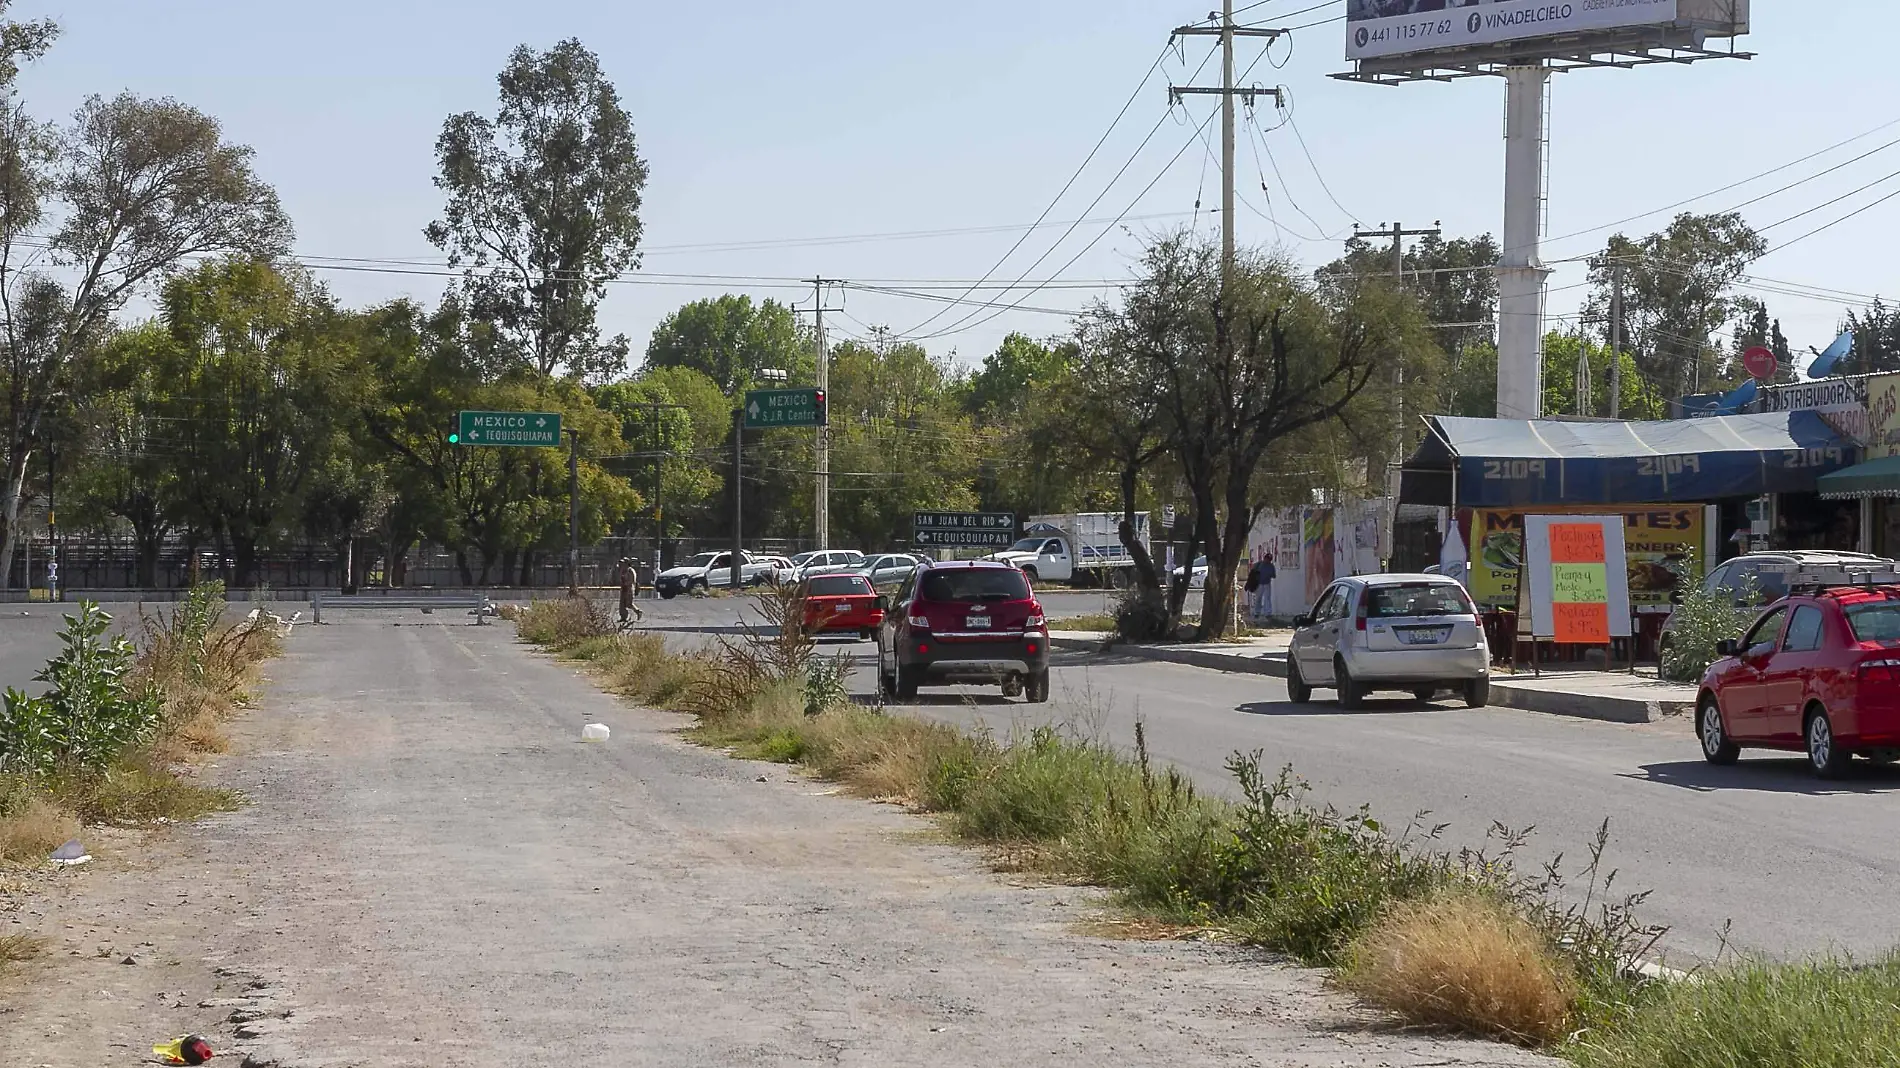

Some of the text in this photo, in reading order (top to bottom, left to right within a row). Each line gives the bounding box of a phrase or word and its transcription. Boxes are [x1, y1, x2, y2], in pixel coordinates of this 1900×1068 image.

[1371, 27, 1391, 42] 441
[1396, 25, 1416, 40] 115
[1420, 22, 1434, 36] 77
[1437, 19, 1451, 34] 62
[1485, 4, 1572, 28] VIÑADELCIELO
[769, 395, 808, 407] MEXICO
[1772, 384, 1851, 411] DISTRIBUIDORA
[474, 416, 526, 427] MEXICO
[486, 430, 553, 442] TEQUISQUIAPAN
[917, 515, 995, 526] SAN JUAN DEL RIO
[932, 532, 1008, 544] TEQUISQUIAPAN
